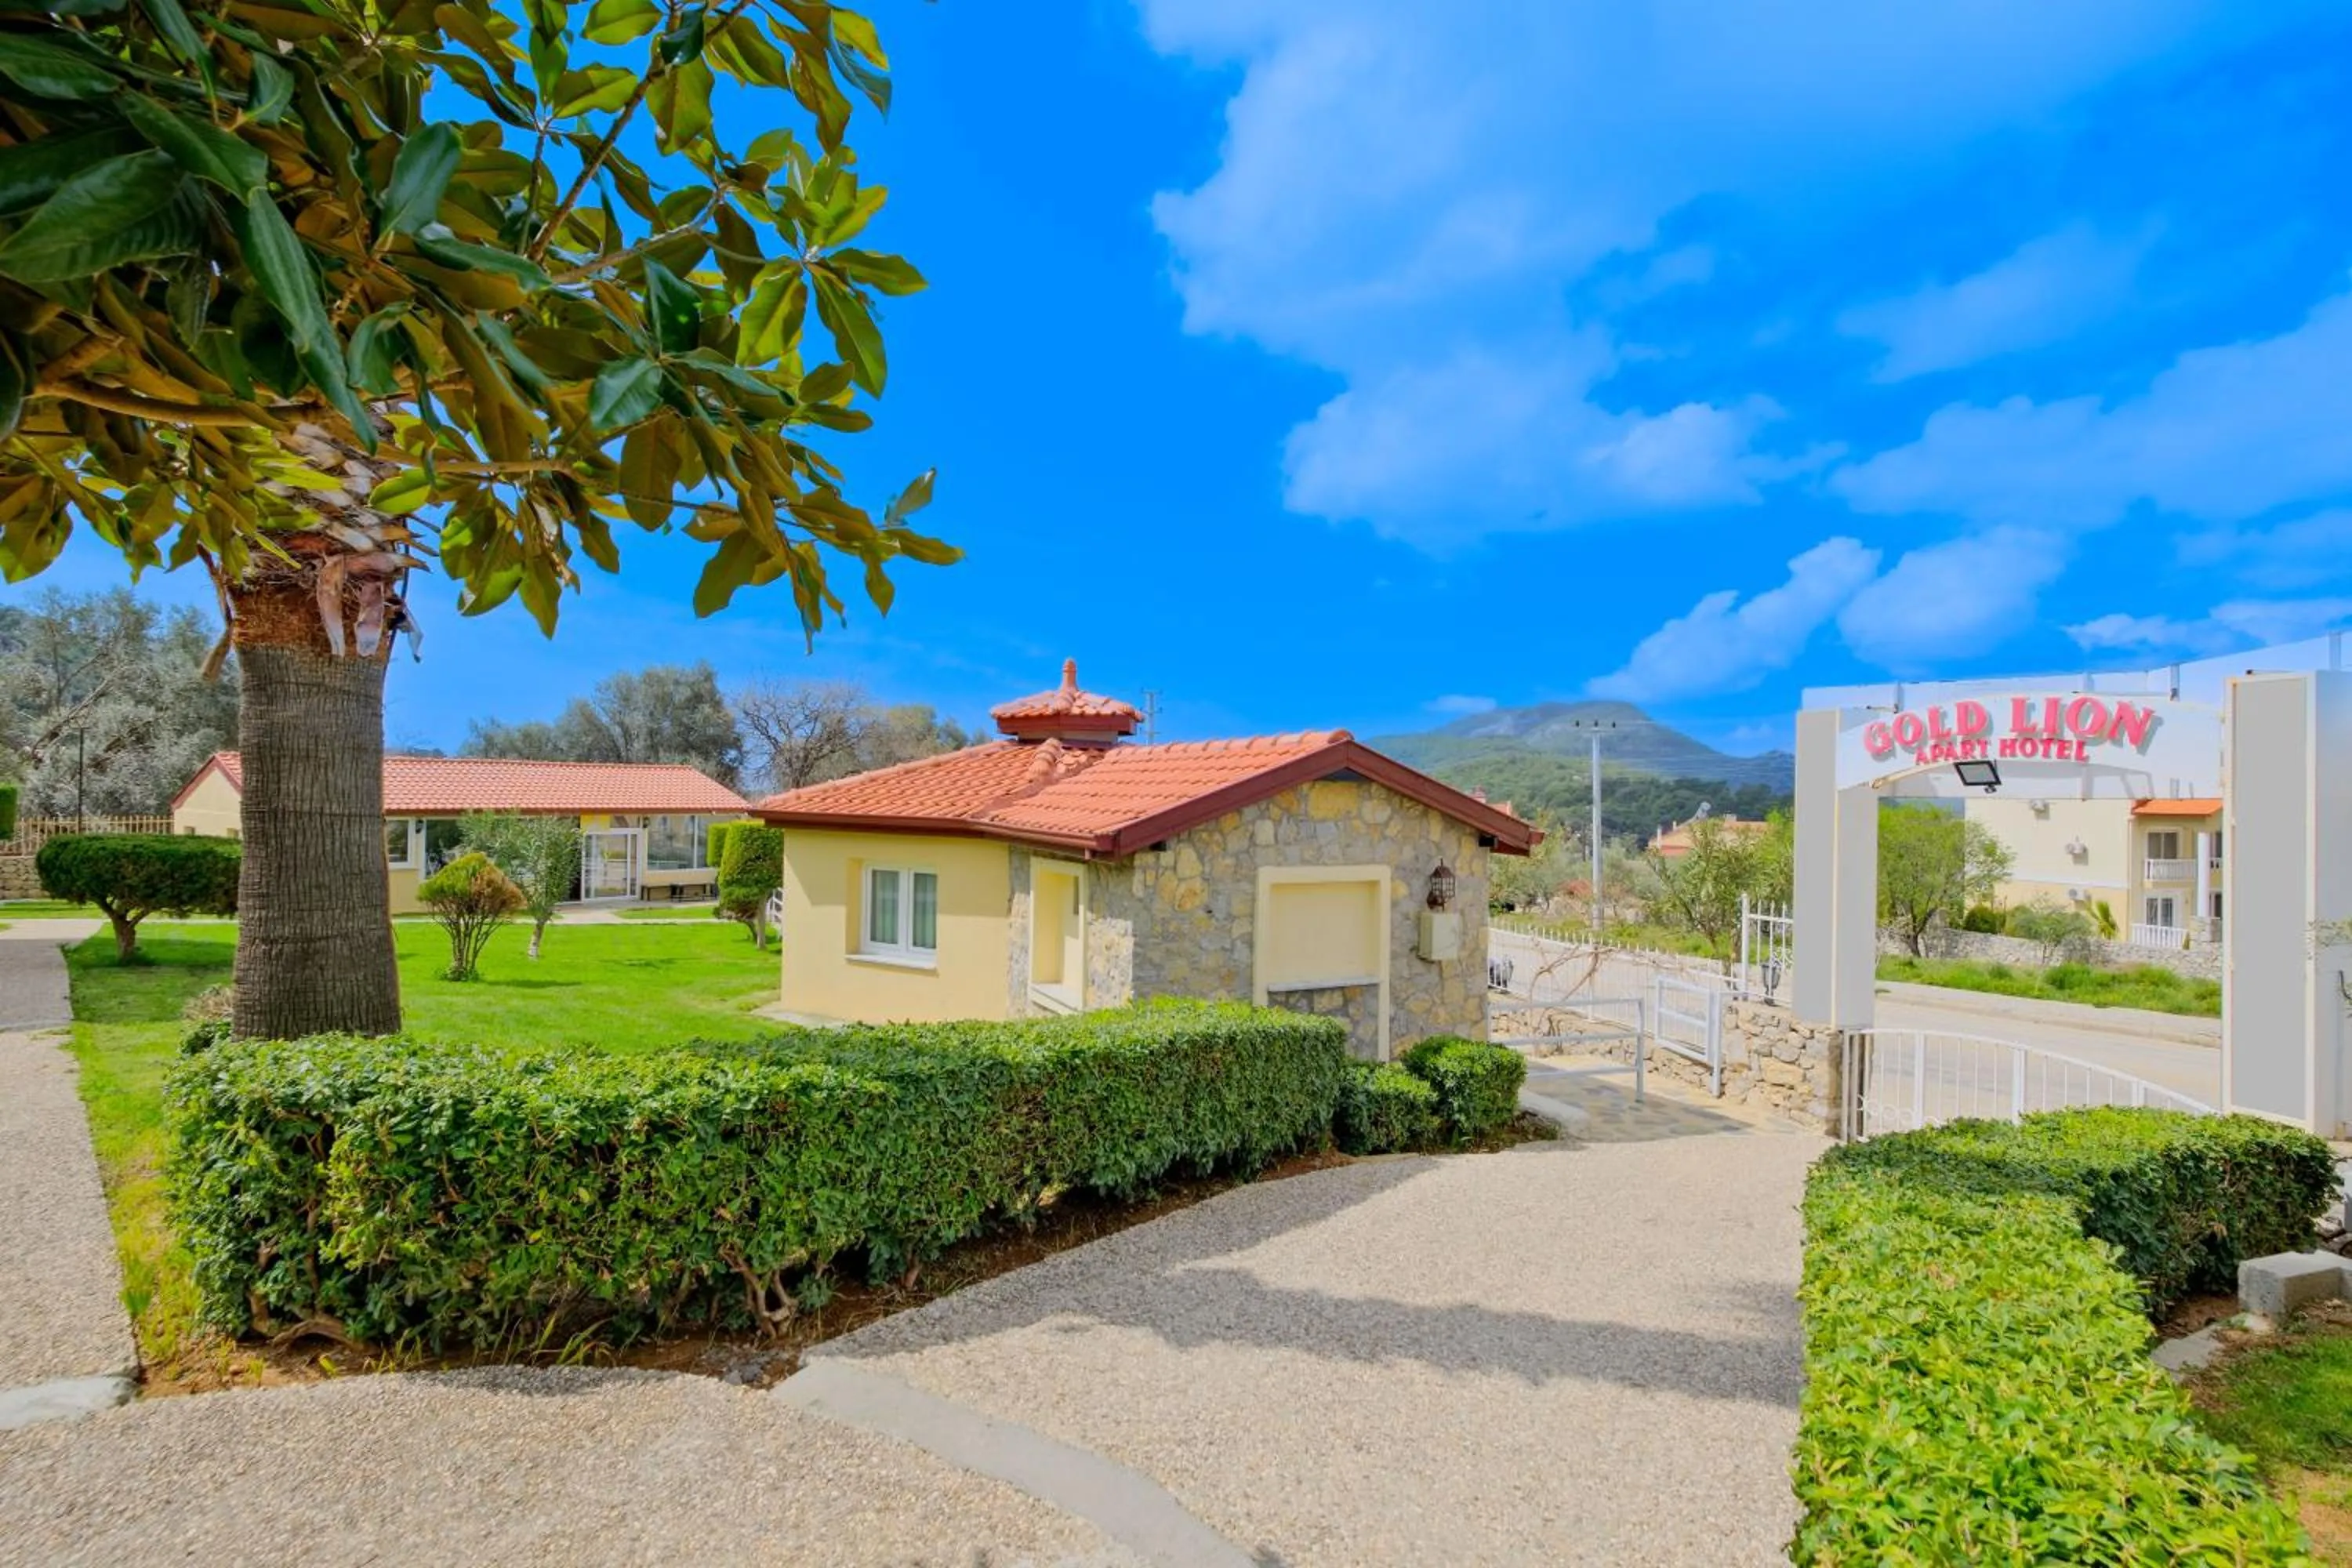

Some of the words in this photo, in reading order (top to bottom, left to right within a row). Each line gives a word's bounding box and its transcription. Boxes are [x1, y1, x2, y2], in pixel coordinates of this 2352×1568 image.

[1864, 700, 1988, 756] GOLD
[2009, 696, 2156, 746] LION
[1915, 739, 1989, 765] APART
[1998, 736, 2089, 762] HOTEL
